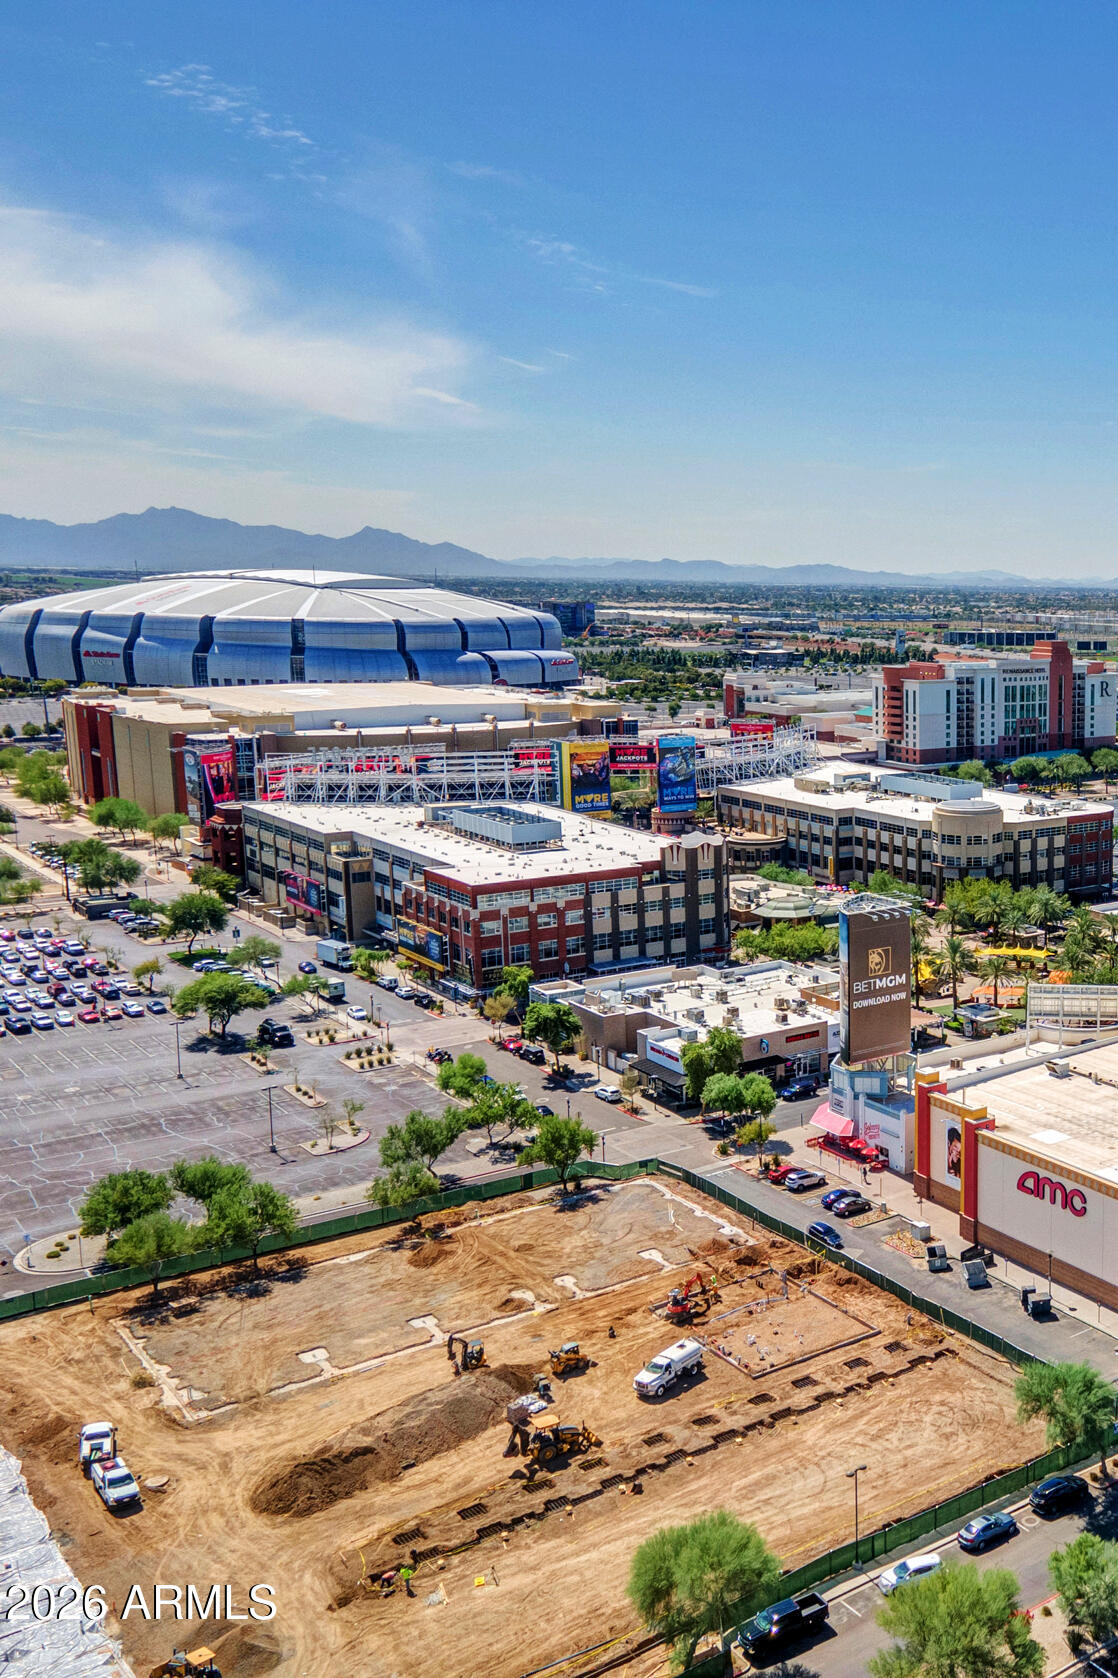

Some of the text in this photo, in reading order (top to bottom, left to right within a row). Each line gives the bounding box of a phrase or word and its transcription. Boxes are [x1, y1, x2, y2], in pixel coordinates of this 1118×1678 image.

[1099, 680, 1112, 698] R
[853, 973, 906, 994] BETMGM
[853, 991, 907, 1009] DOWNLOAD NOW
